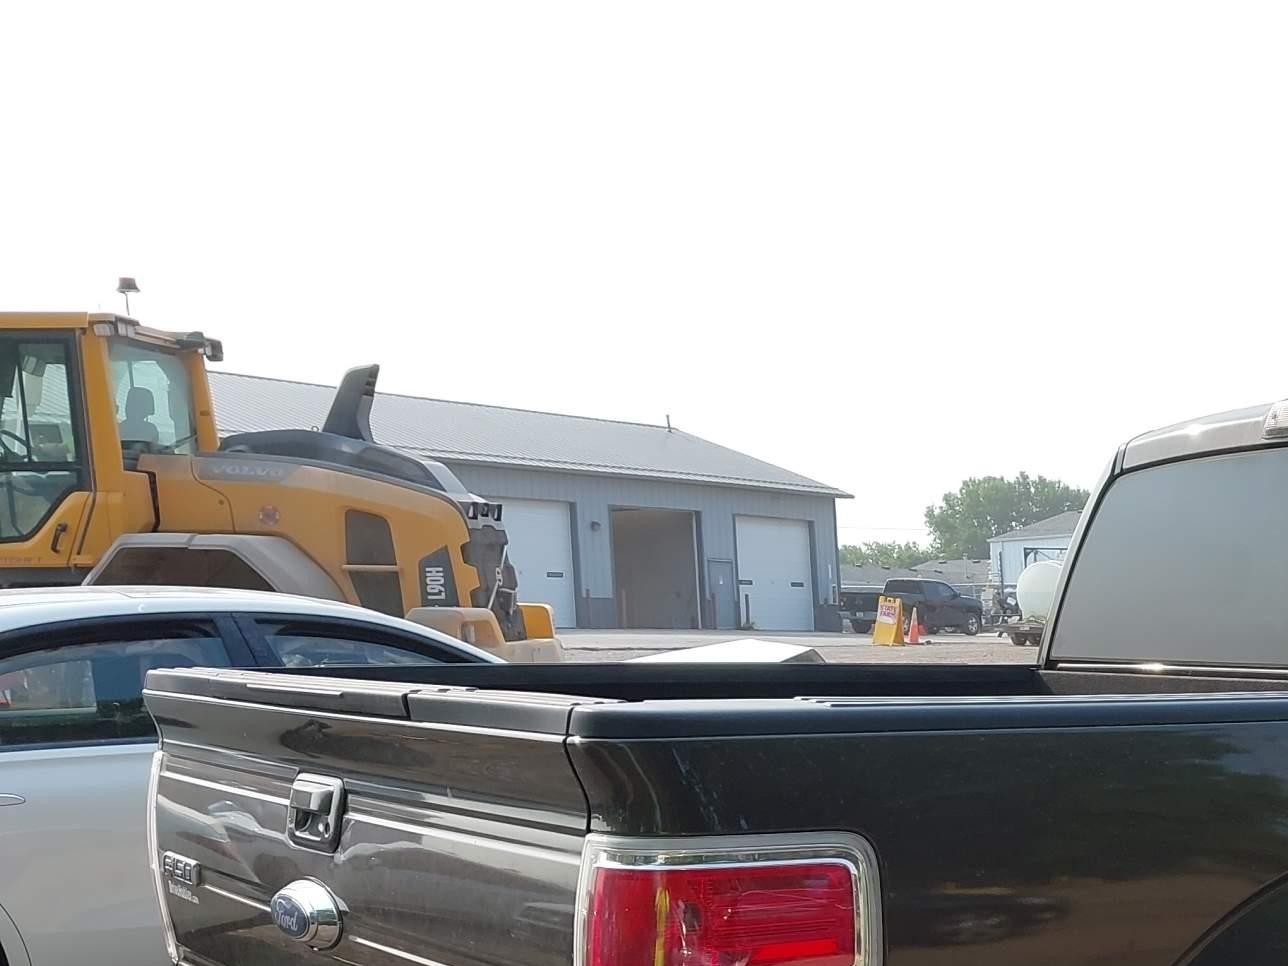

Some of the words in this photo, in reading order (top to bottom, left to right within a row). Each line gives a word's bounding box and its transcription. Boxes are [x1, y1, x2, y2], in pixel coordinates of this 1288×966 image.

[211, 464, 285, 477] VOLVO
[425, 567, 446, 600] L90H
[275, 899, 299, 931] Ford
